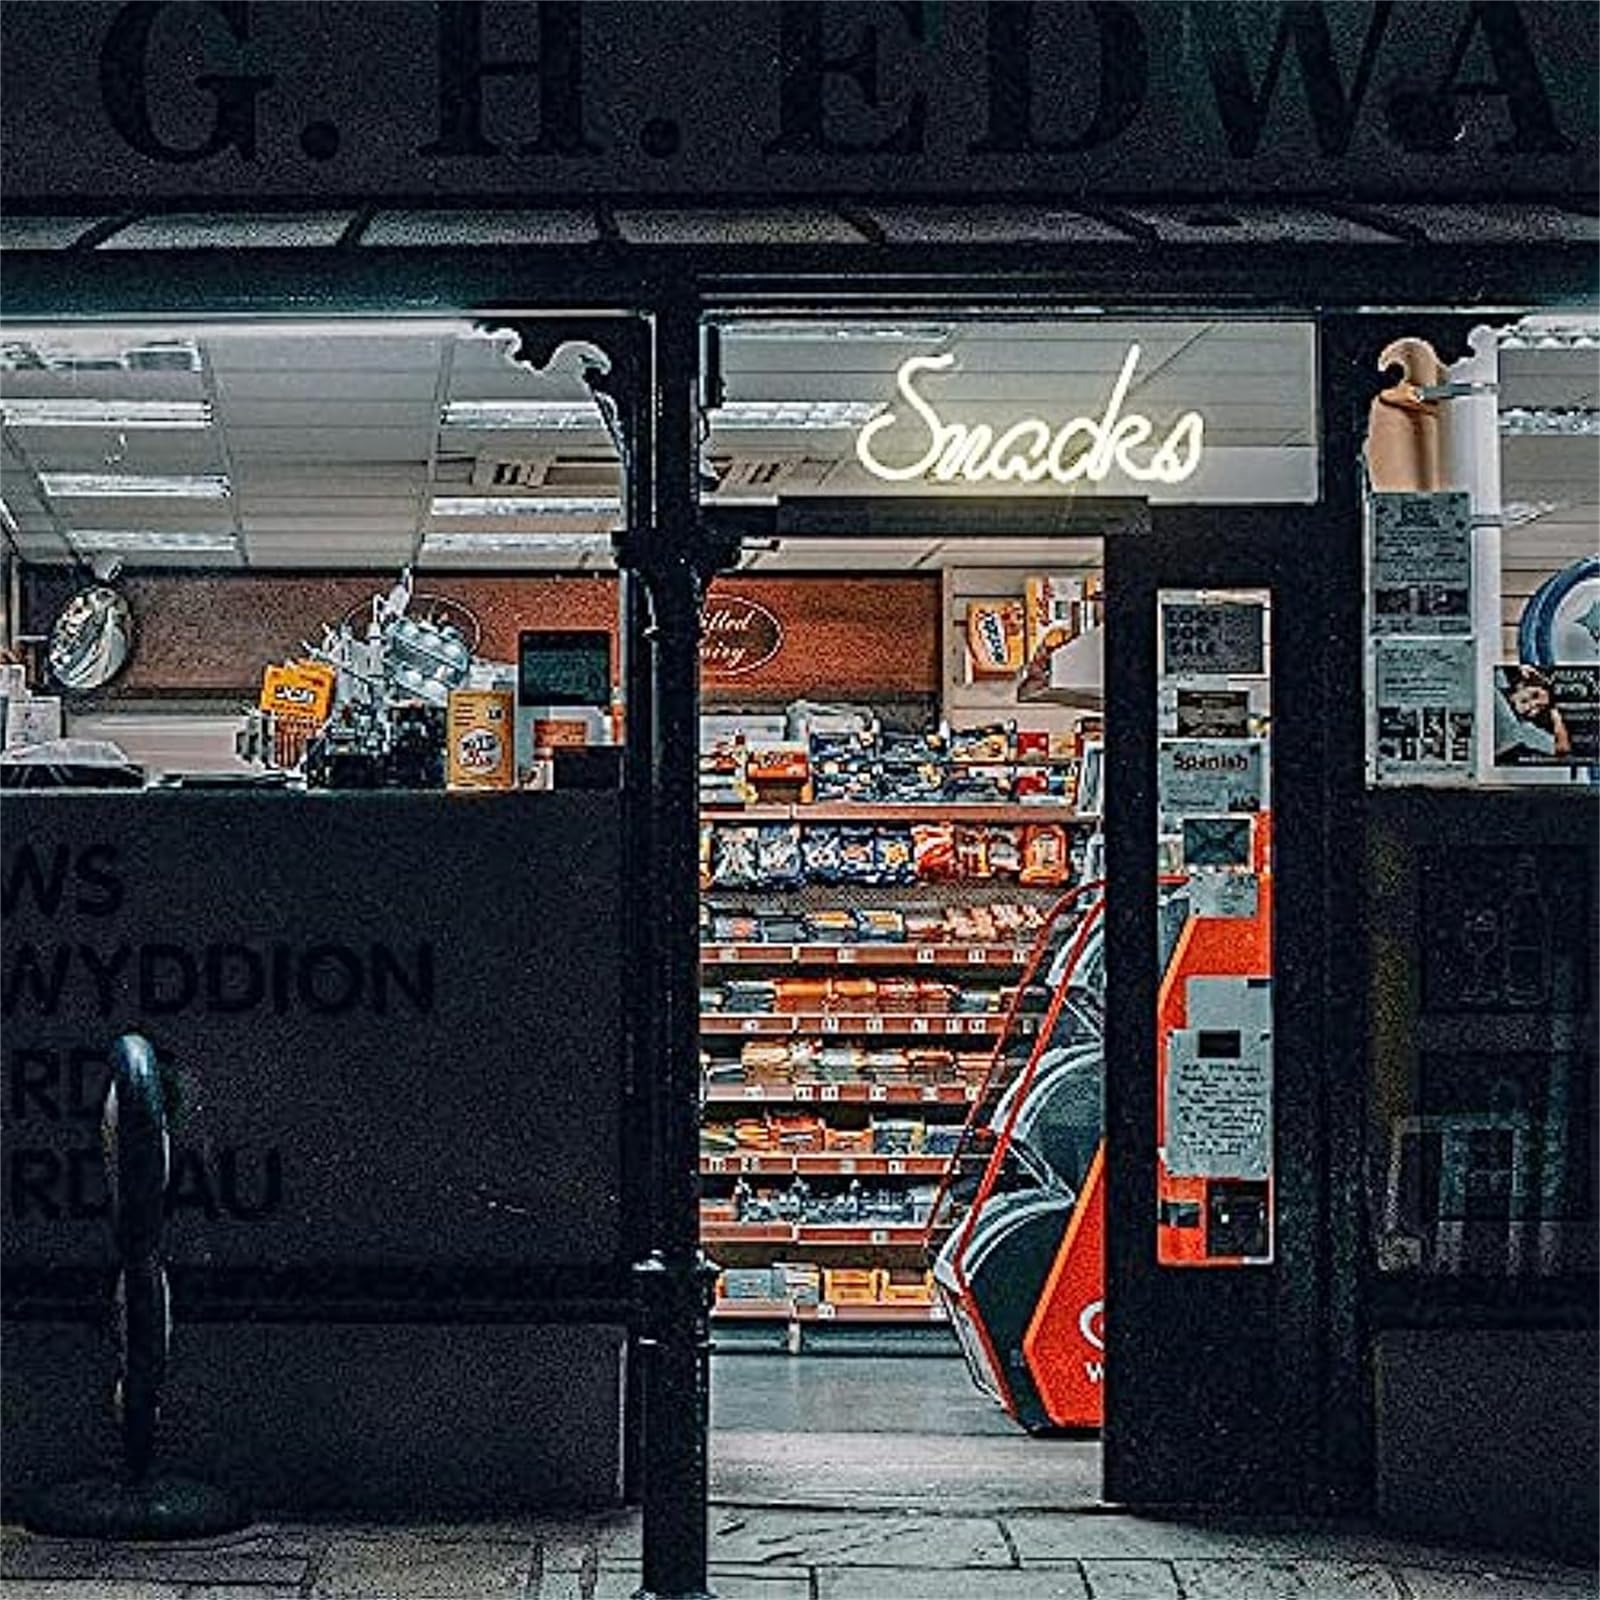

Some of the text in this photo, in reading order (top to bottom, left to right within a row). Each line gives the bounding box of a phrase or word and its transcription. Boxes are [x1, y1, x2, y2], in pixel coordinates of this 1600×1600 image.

[760, 0, 1578, 159] EDWA
[856, 342, 1206, 483] Snacks
[699, 610, 756, 632] illed
[1173, 751, 1249, 770] Spanish
[10, 1147, 282, 1220] RDAU
